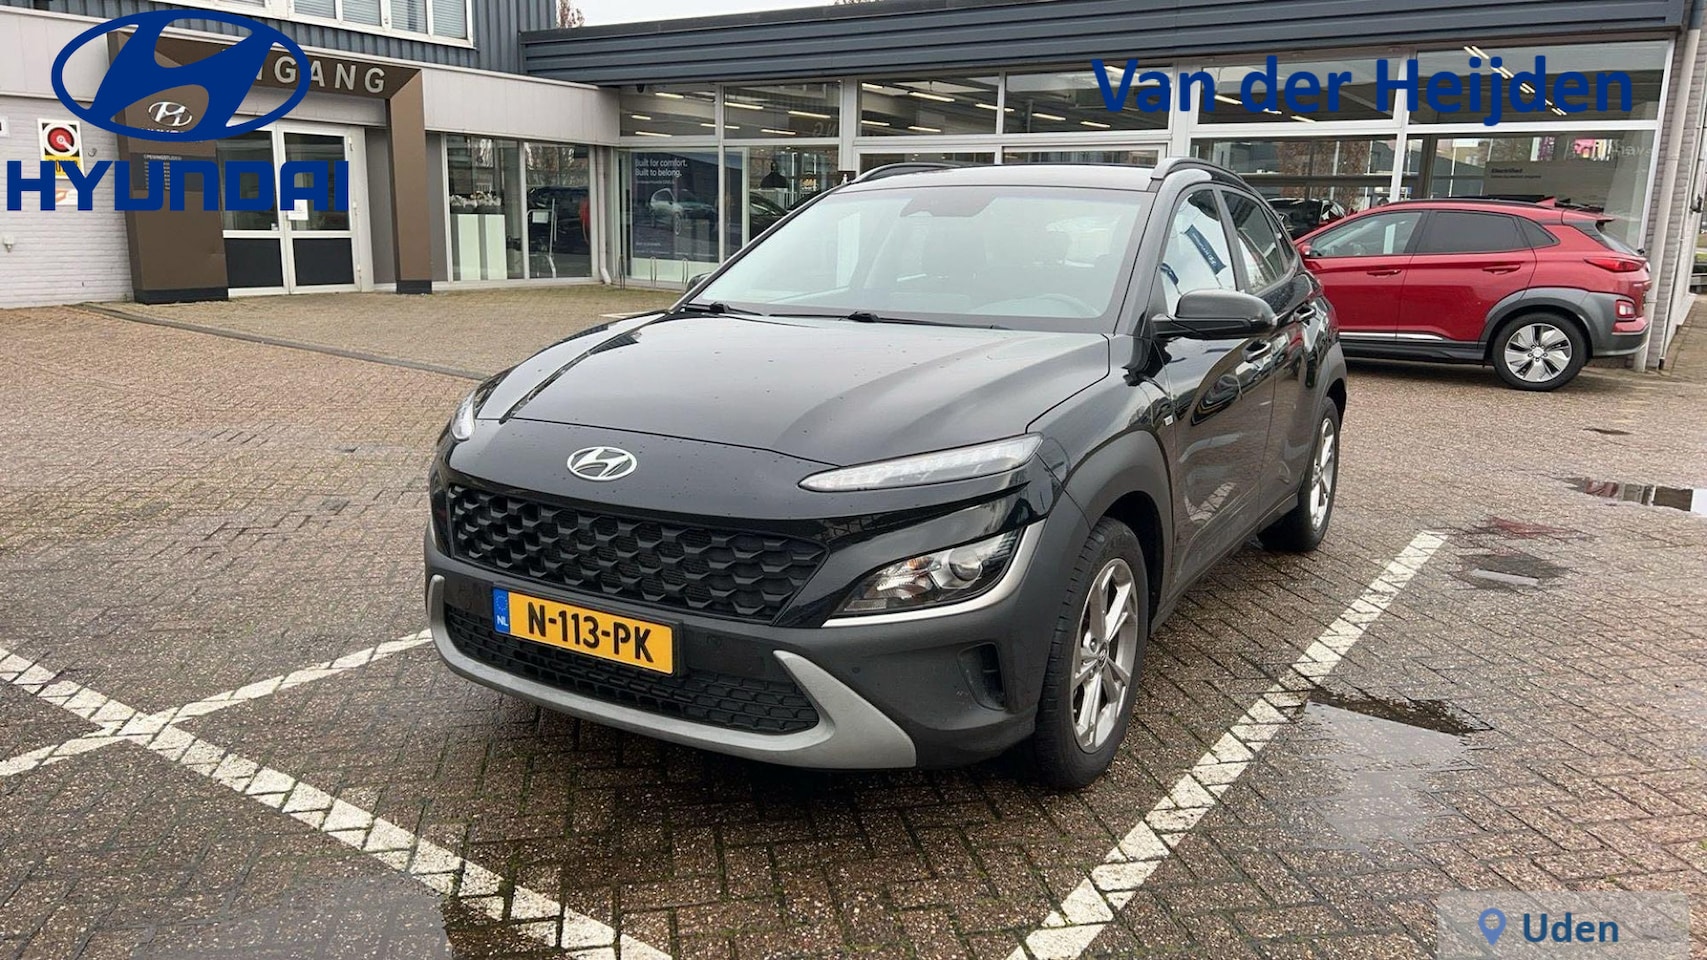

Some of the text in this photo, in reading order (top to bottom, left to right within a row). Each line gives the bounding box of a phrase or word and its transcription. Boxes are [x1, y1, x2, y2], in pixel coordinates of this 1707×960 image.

[634, 158, 688, 168] Built for comfort.
[634, 168, 648, 176] Built
[657, 168, 682, 178] belong.
[496, 615, 509, 627] NL
[528, 601, 654, 663] N-113-PK
